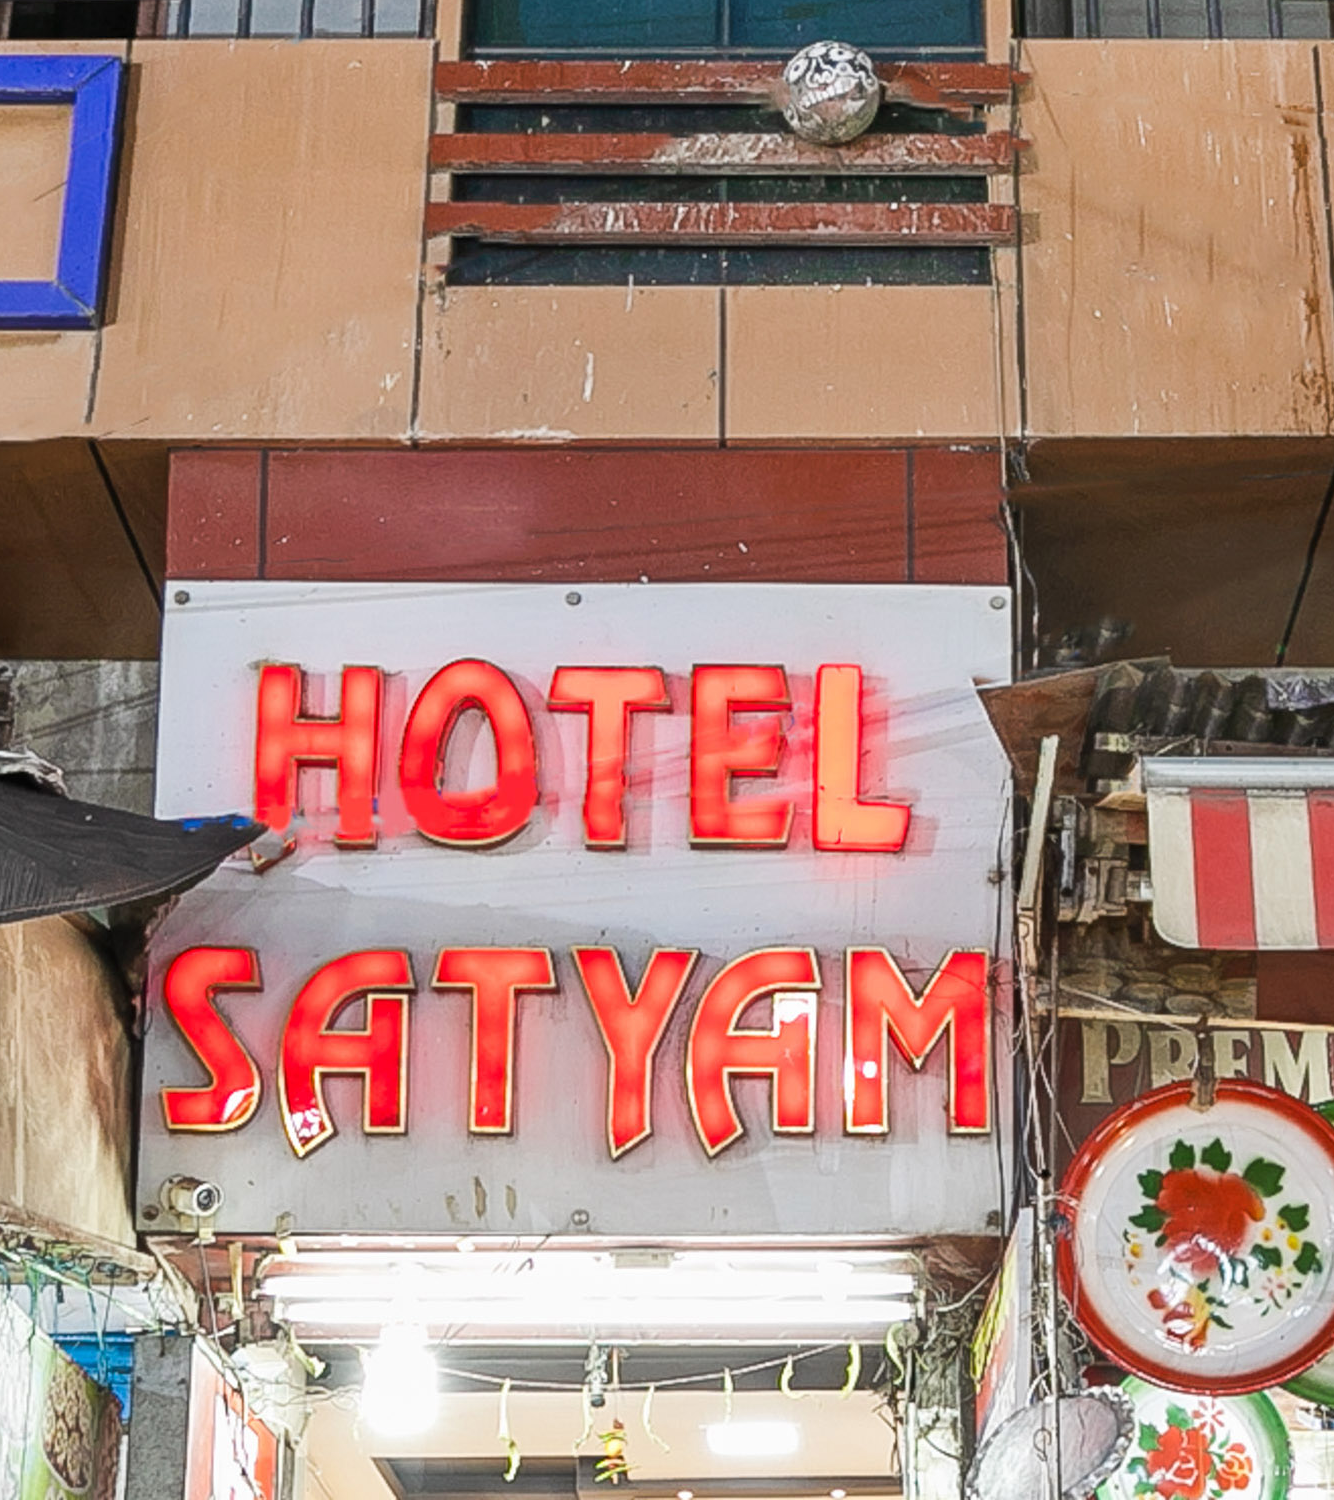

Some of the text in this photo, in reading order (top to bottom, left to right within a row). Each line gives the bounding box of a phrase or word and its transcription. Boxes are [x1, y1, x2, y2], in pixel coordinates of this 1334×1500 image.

[251, 657, 914, 860] HOTEL
[159, 946, 995, 1160] SATYAM
[1080, 1020, 1334, 1106] PREM
